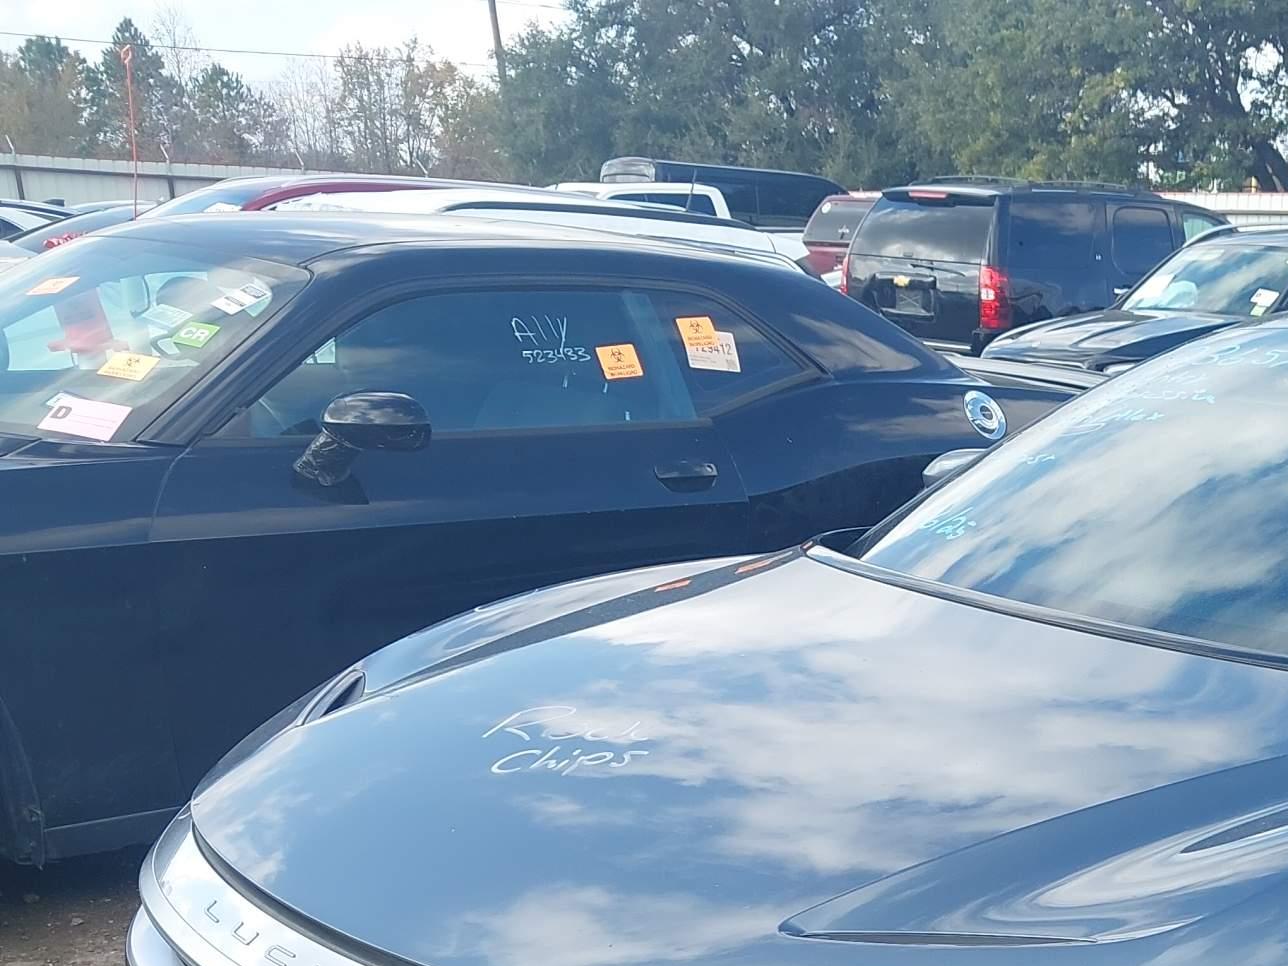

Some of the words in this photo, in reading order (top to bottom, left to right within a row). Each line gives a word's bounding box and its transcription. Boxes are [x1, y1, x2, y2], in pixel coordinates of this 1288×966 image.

[180, 327, 208, 342] CR
[50, 405, 72, 420] D
[490, 746, 649, 776] Chips
